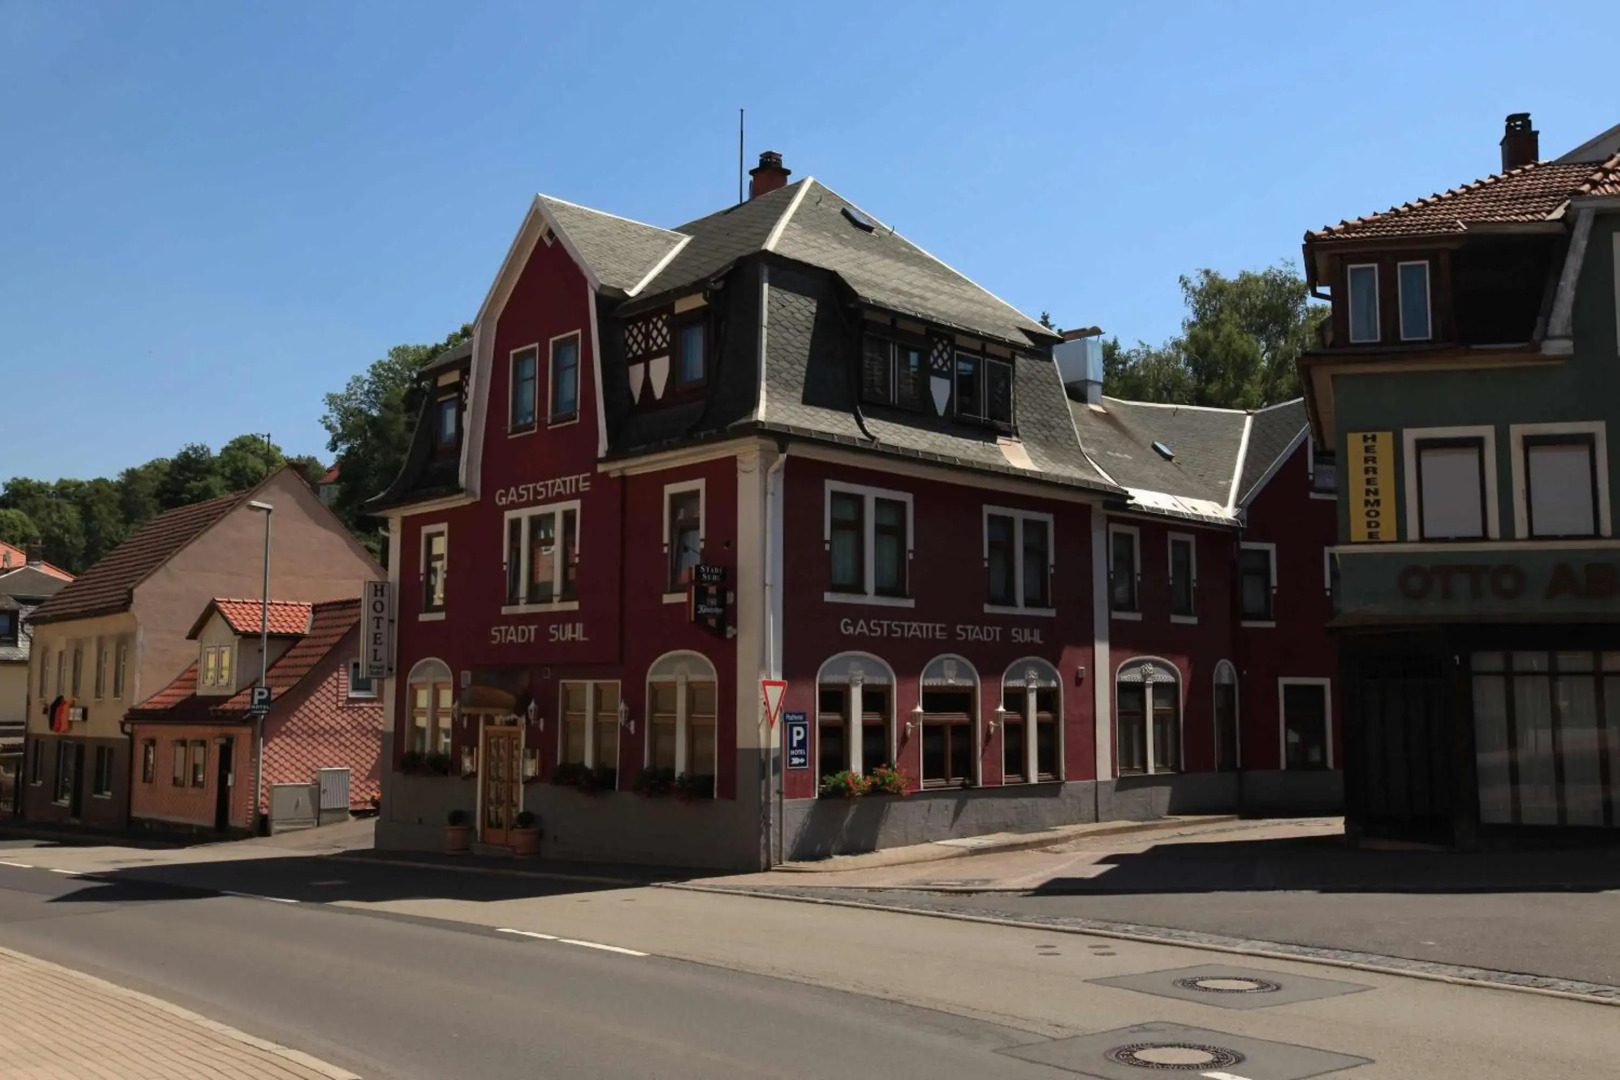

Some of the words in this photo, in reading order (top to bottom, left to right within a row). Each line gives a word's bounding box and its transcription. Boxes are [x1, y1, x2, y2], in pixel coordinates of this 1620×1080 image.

[1362, 434, 1381, 540] HERRENMODE
[1397, 563, 1526, 600] OTTO
[372, 583, 385, 662] HOTEL
[491, 625, 538, 644] STADT
[549, 623, 589, 642] SUHL
[956, 625, 1003, 642] STADT
[1011, 627, 1044, 644] SUHL
[254, 687, 268, 704] P
[793, 726, 805, 747] P
